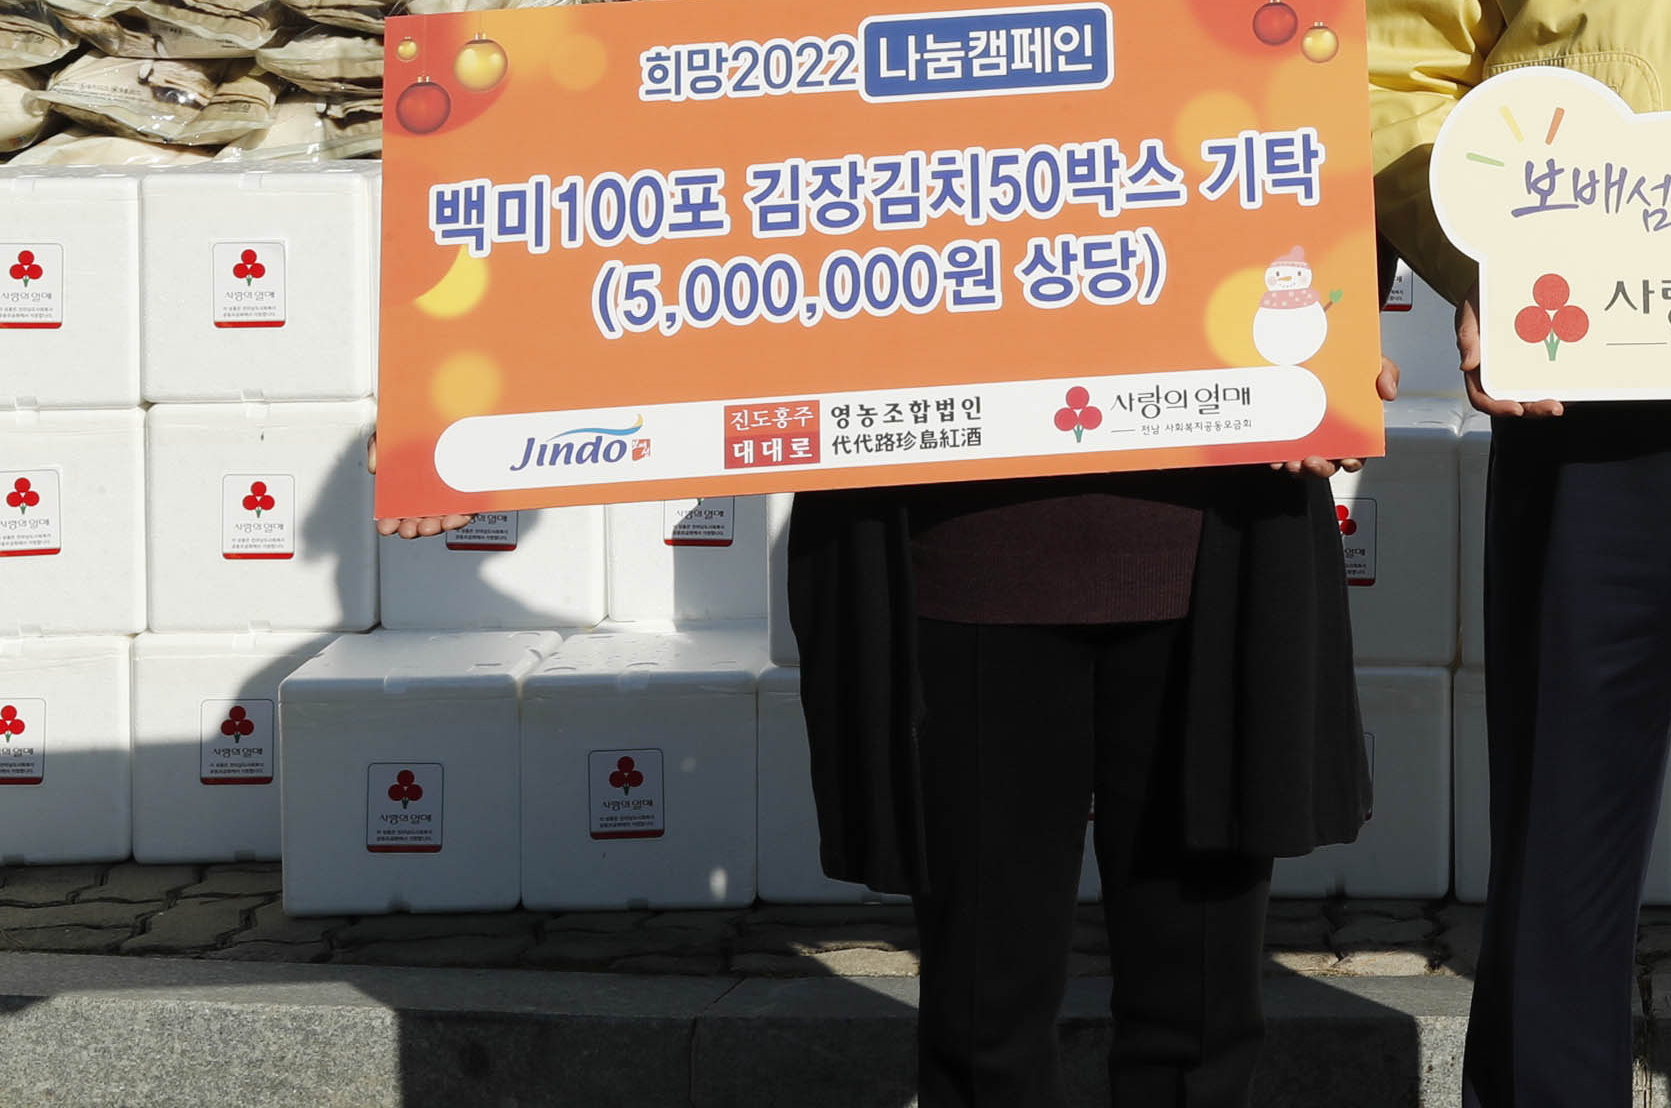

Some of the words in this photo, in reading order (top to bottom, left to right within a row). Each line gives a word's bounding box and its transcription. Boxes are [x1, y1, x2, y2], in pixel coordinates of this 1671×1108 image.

[643, 42, 857, 99] 희망2022
[877, 21, 1094, 82] 나눔캠페인
[433, 169, 727, 253] 백미100포
[750, 143, 1183, 235] 김장김치50박스
[1203, 132, 1321, 206] 기탁
[596, 242, 1000, 337] (5,000,000원
[1020, 230, 1166, 303] 상당)
[730, 406, 815, 432] 진도홍주
[830, 396, 982, 431] 영농조합법인
[510, 435, 627, 472] Jindo
[732, 435, 814, 465] 대대로
[831, 425, 982, 456] 代代路珍島紅酒
